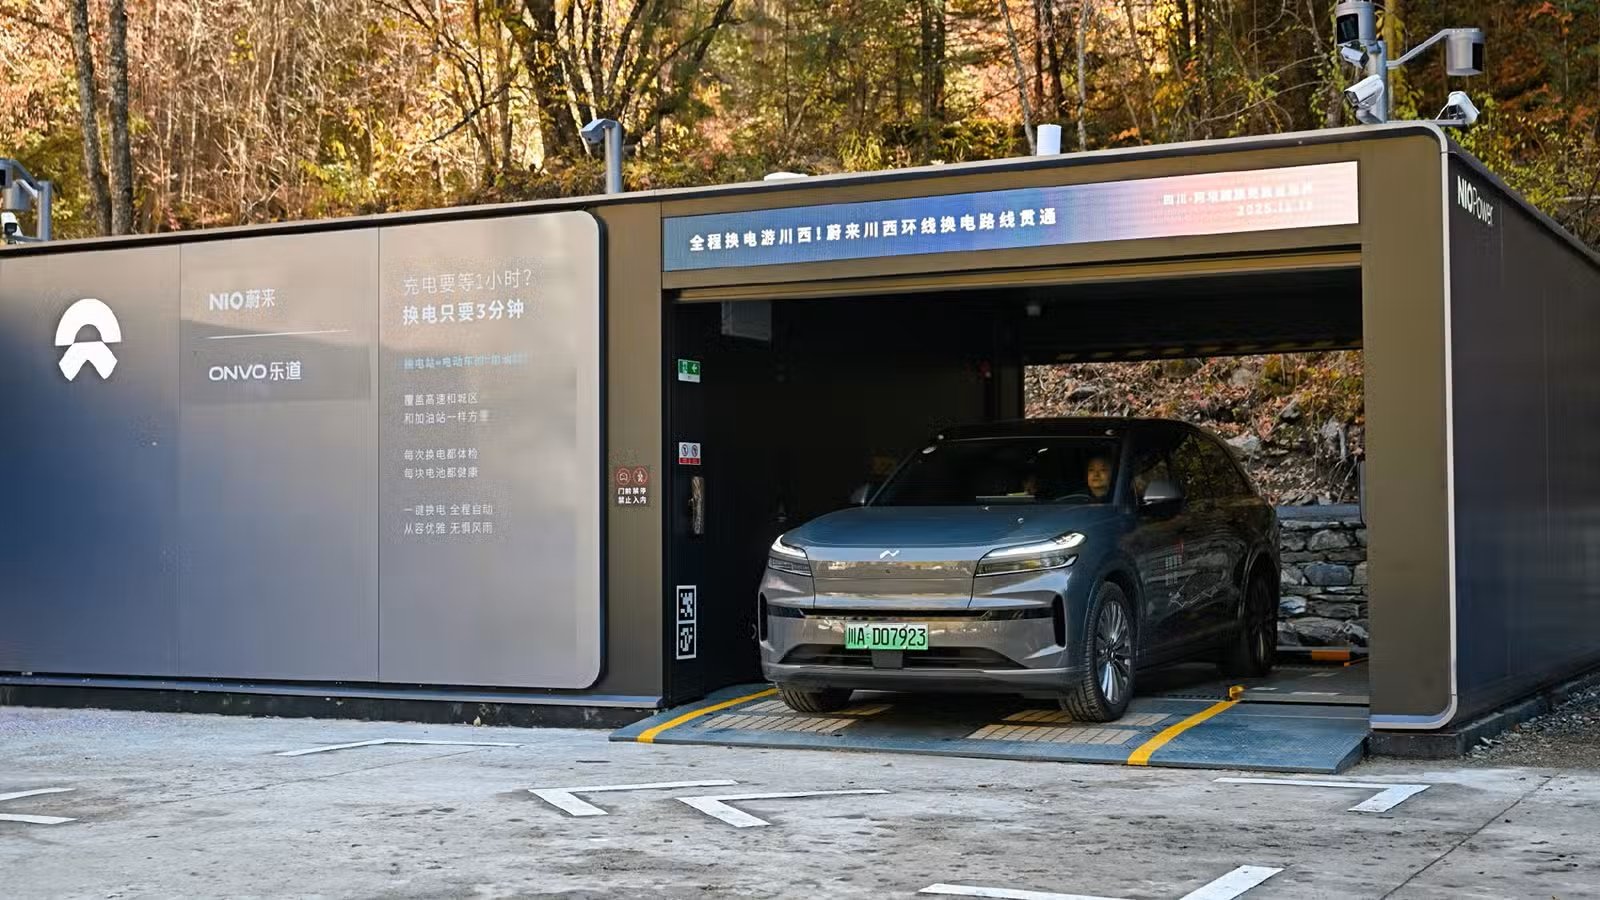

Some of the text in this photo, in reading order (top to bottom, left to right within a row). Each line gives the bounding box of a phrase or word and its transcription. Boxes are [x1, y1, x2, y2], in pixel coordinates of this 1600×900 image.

[402, 298, 525, 325] 换电只要3分钟
[404, 392, 478, 407] 覆盖高速和城区
[404, 409, 488, 425] 和加油站一样方
[404, 447, 478, 461] 每次换电都体检
[404, 466, 479, 479] 每块电池都健康
[617, 495, 647, 504] 禁止入内
[403, 503, 493, 516] 一键换电 全程自动
[403, 521, 493, 535] 从容优雅 无惧风雨
